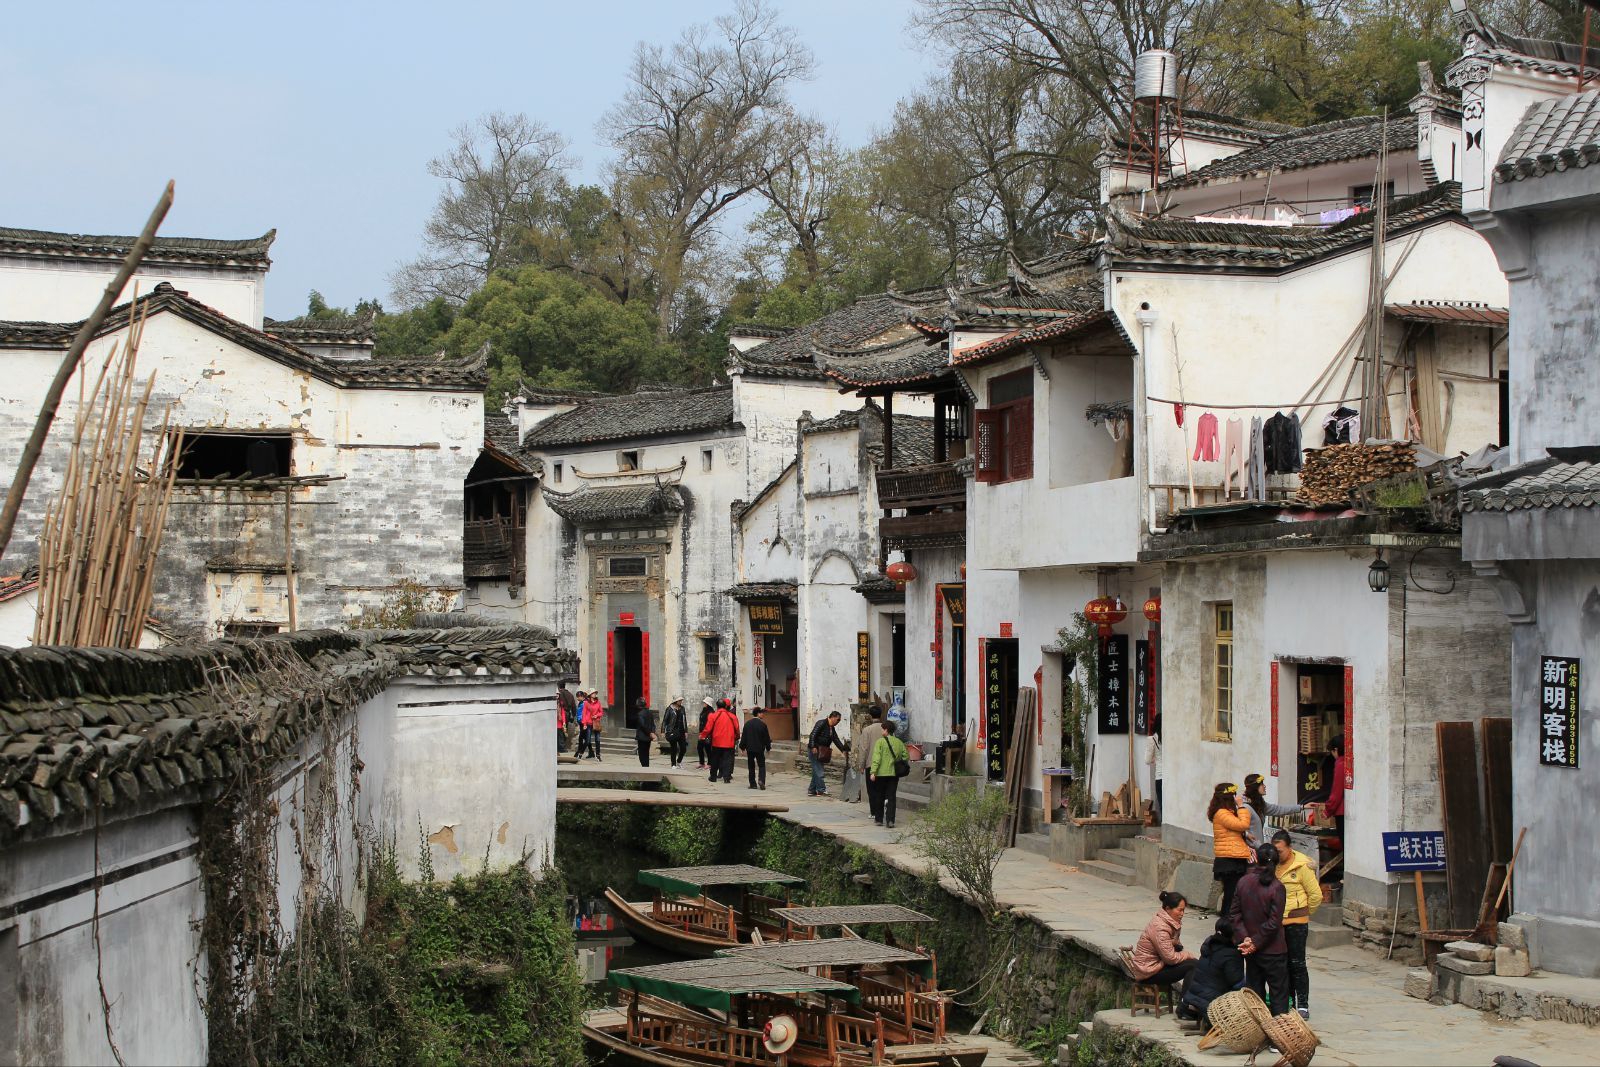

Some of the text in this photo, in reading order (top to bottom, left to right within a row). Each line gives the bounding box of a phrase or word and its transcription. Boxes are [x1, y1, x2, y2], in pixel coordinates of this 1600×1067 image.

[989, 653, 1001, 772] 品质但求问心无愧
[1542, 659, 1567, 763] 新明客栈
[1387, 836, 1446, 859] 一线天古屋
